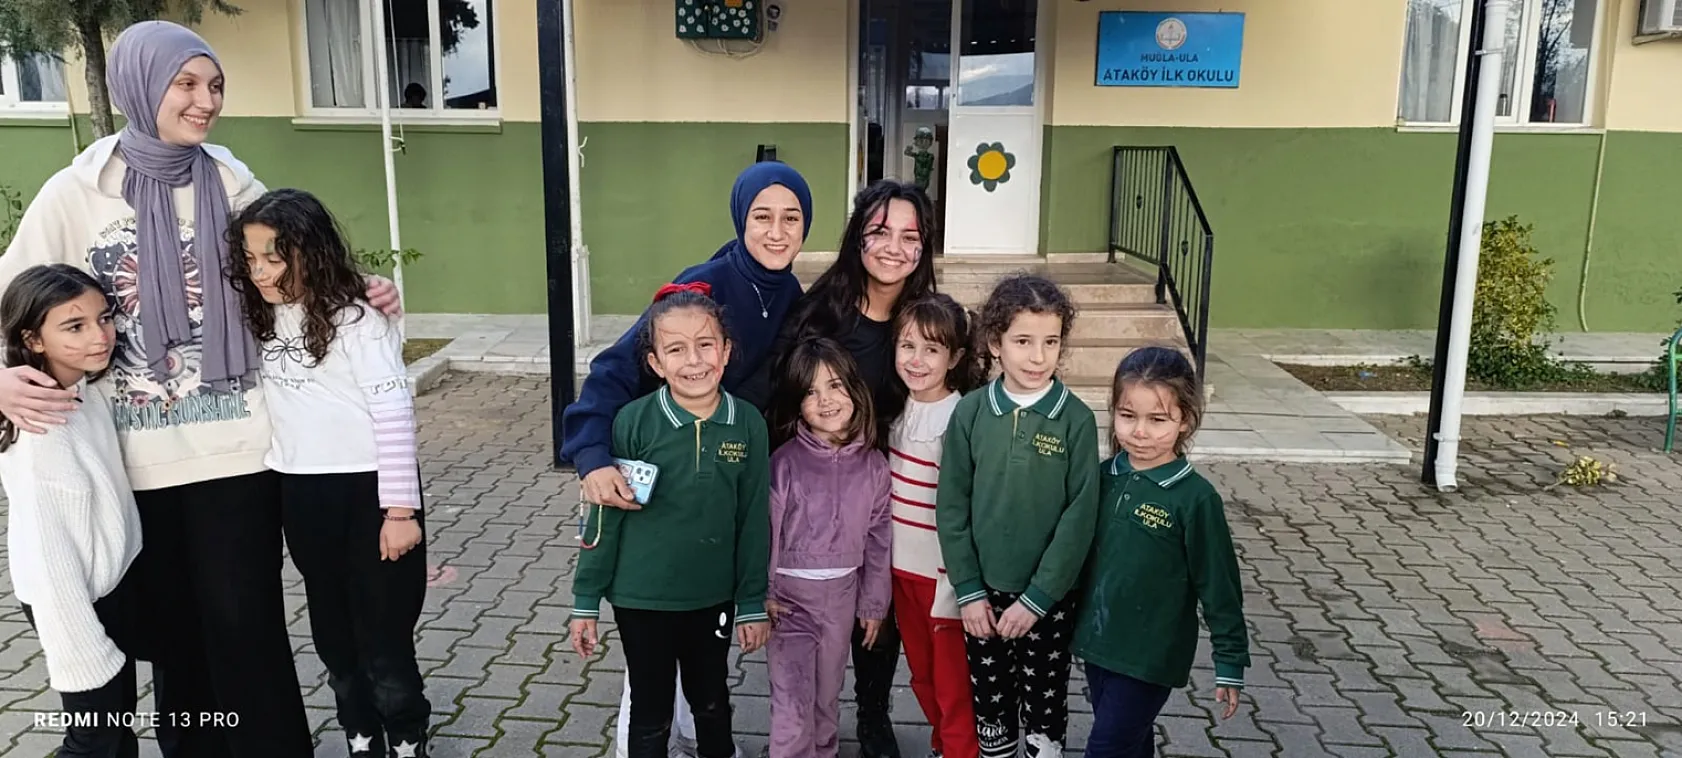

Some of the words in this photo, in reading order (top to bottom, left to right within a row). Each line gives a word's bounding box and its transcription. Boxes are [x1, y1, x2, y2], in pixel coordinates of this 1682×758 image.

[1103, 67, 1159, 81] ATAKÖY
[1161, 66, 1184, 81] İLK
[1187, 70, 1234, 82] OKULU
